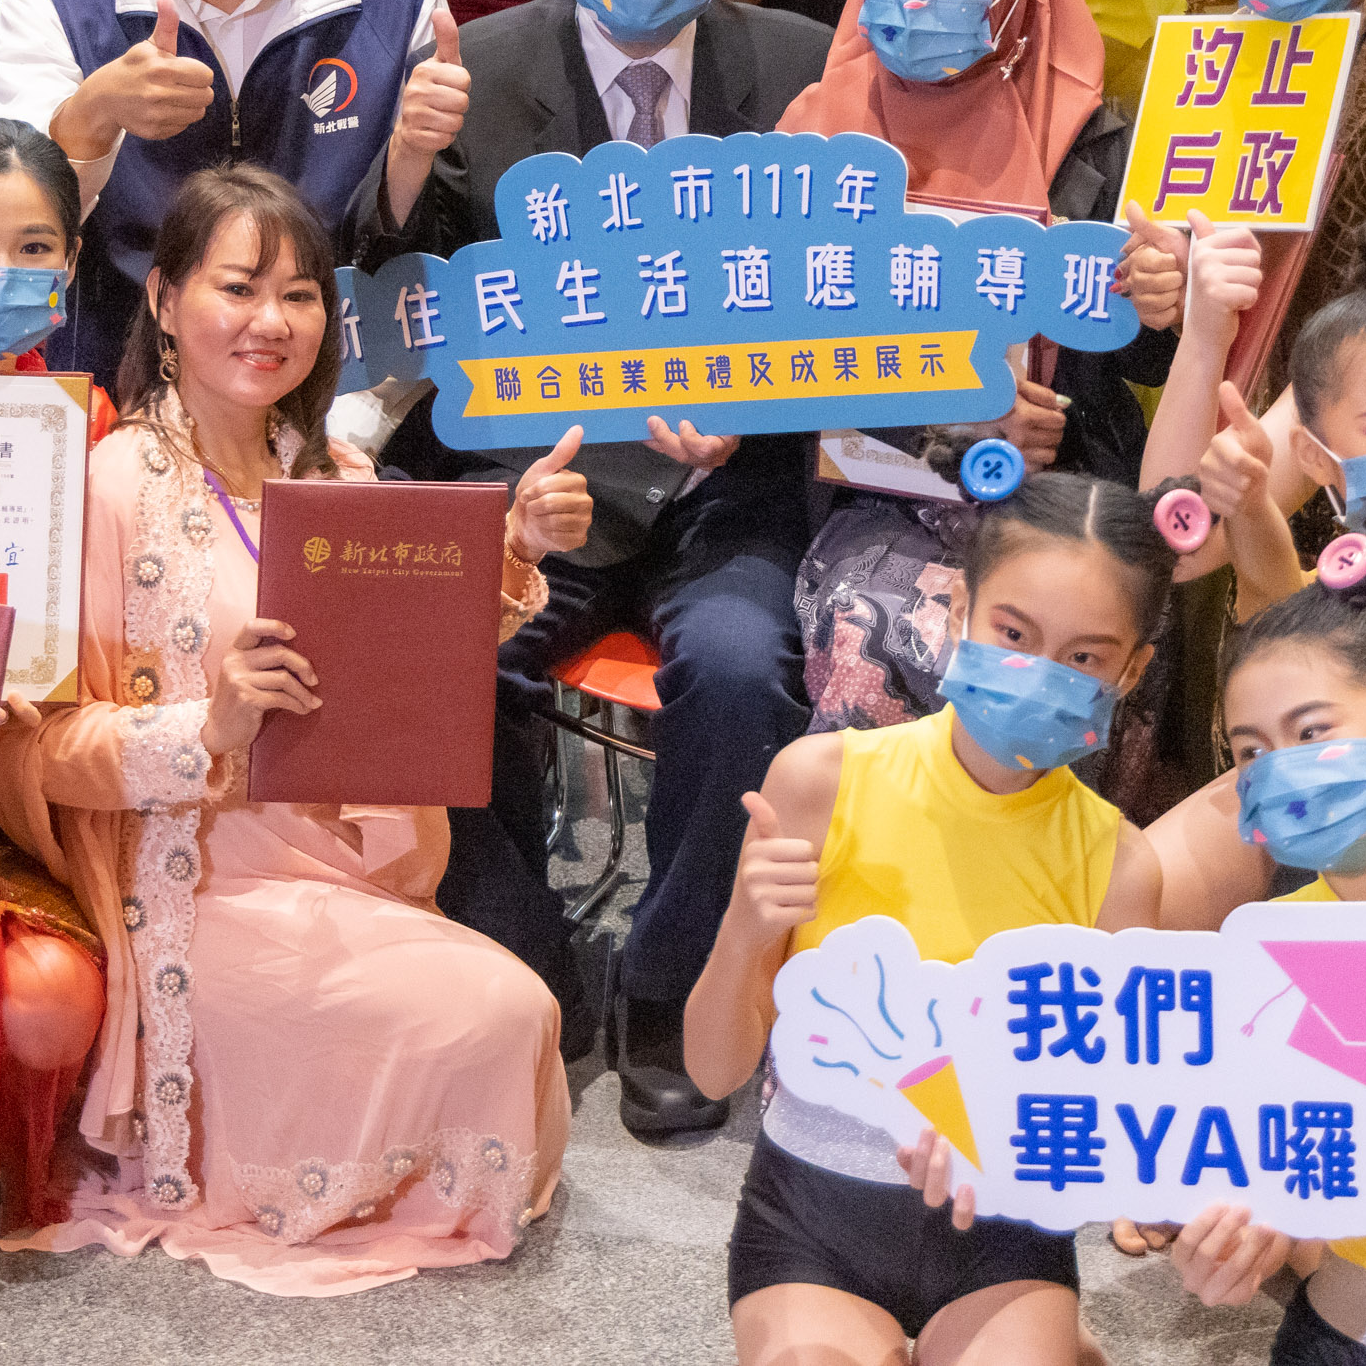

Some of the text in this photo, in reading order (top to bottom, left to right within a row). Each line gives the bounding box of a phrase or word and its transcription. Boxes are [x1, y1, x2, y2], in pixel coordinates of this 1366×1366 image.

[1175, 24, 1316, 109] 汐止
[525, 162, 879, 246] 新北市111年
[1152, 131, 1297, 216] 戶政
[493, 342, 947, 403] 聯合結業典禮及成果展示
[338, 539, 463, 567] 新北市政府
[341, 566, 464, 578] New Taipei City Government
[1005, 960, 1215, 1068] 我們
